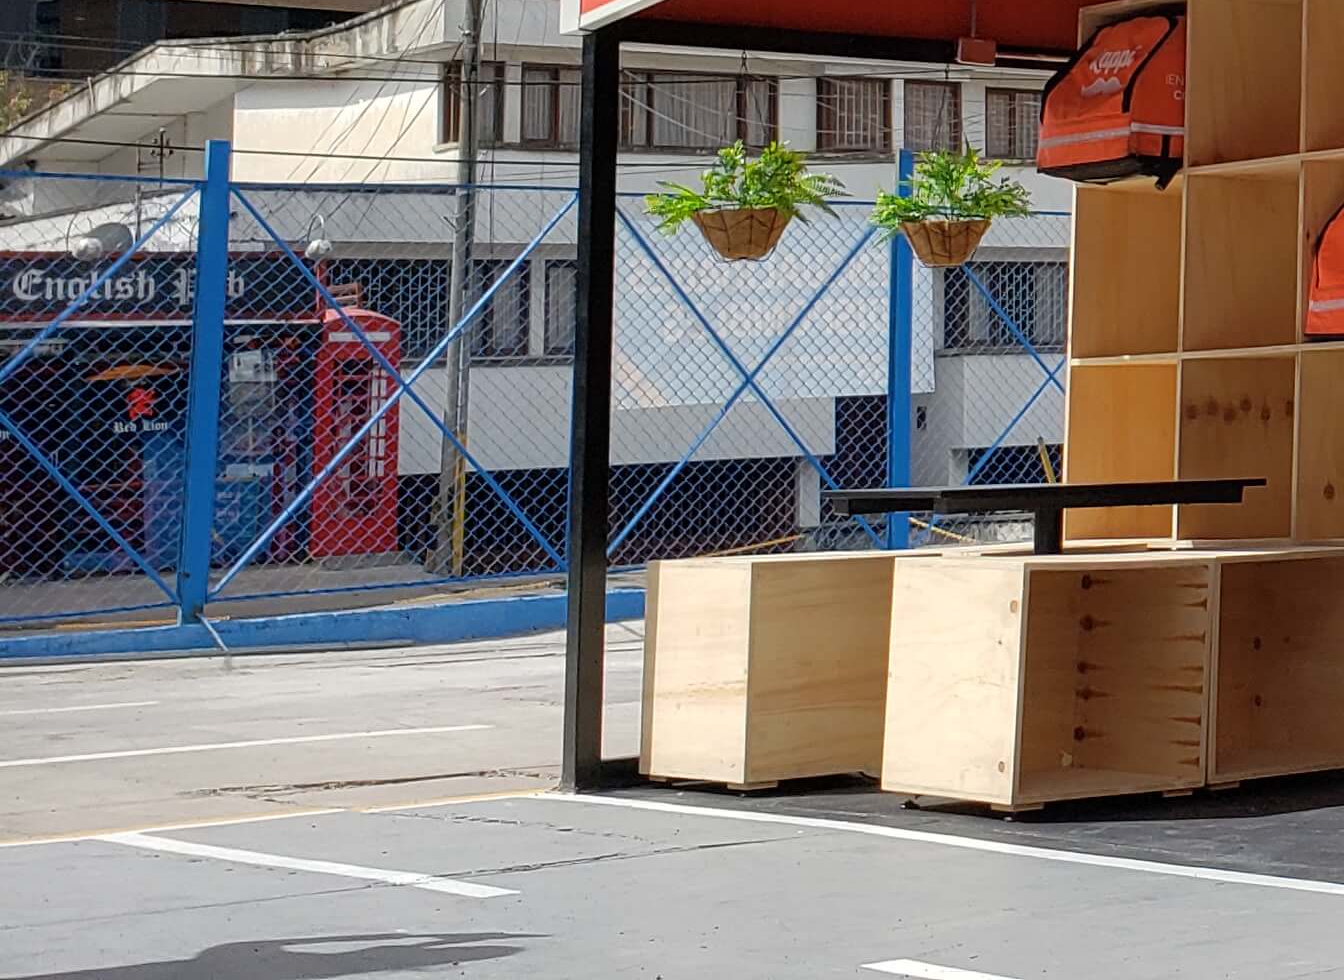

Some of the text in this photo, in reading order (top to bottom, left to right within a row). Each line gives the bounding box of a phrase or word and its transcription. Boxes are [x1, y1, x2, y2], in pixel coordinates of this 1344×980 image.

[12, 268, 245, 306] English Pb
[113, 420, 169, 433] Red Lion
